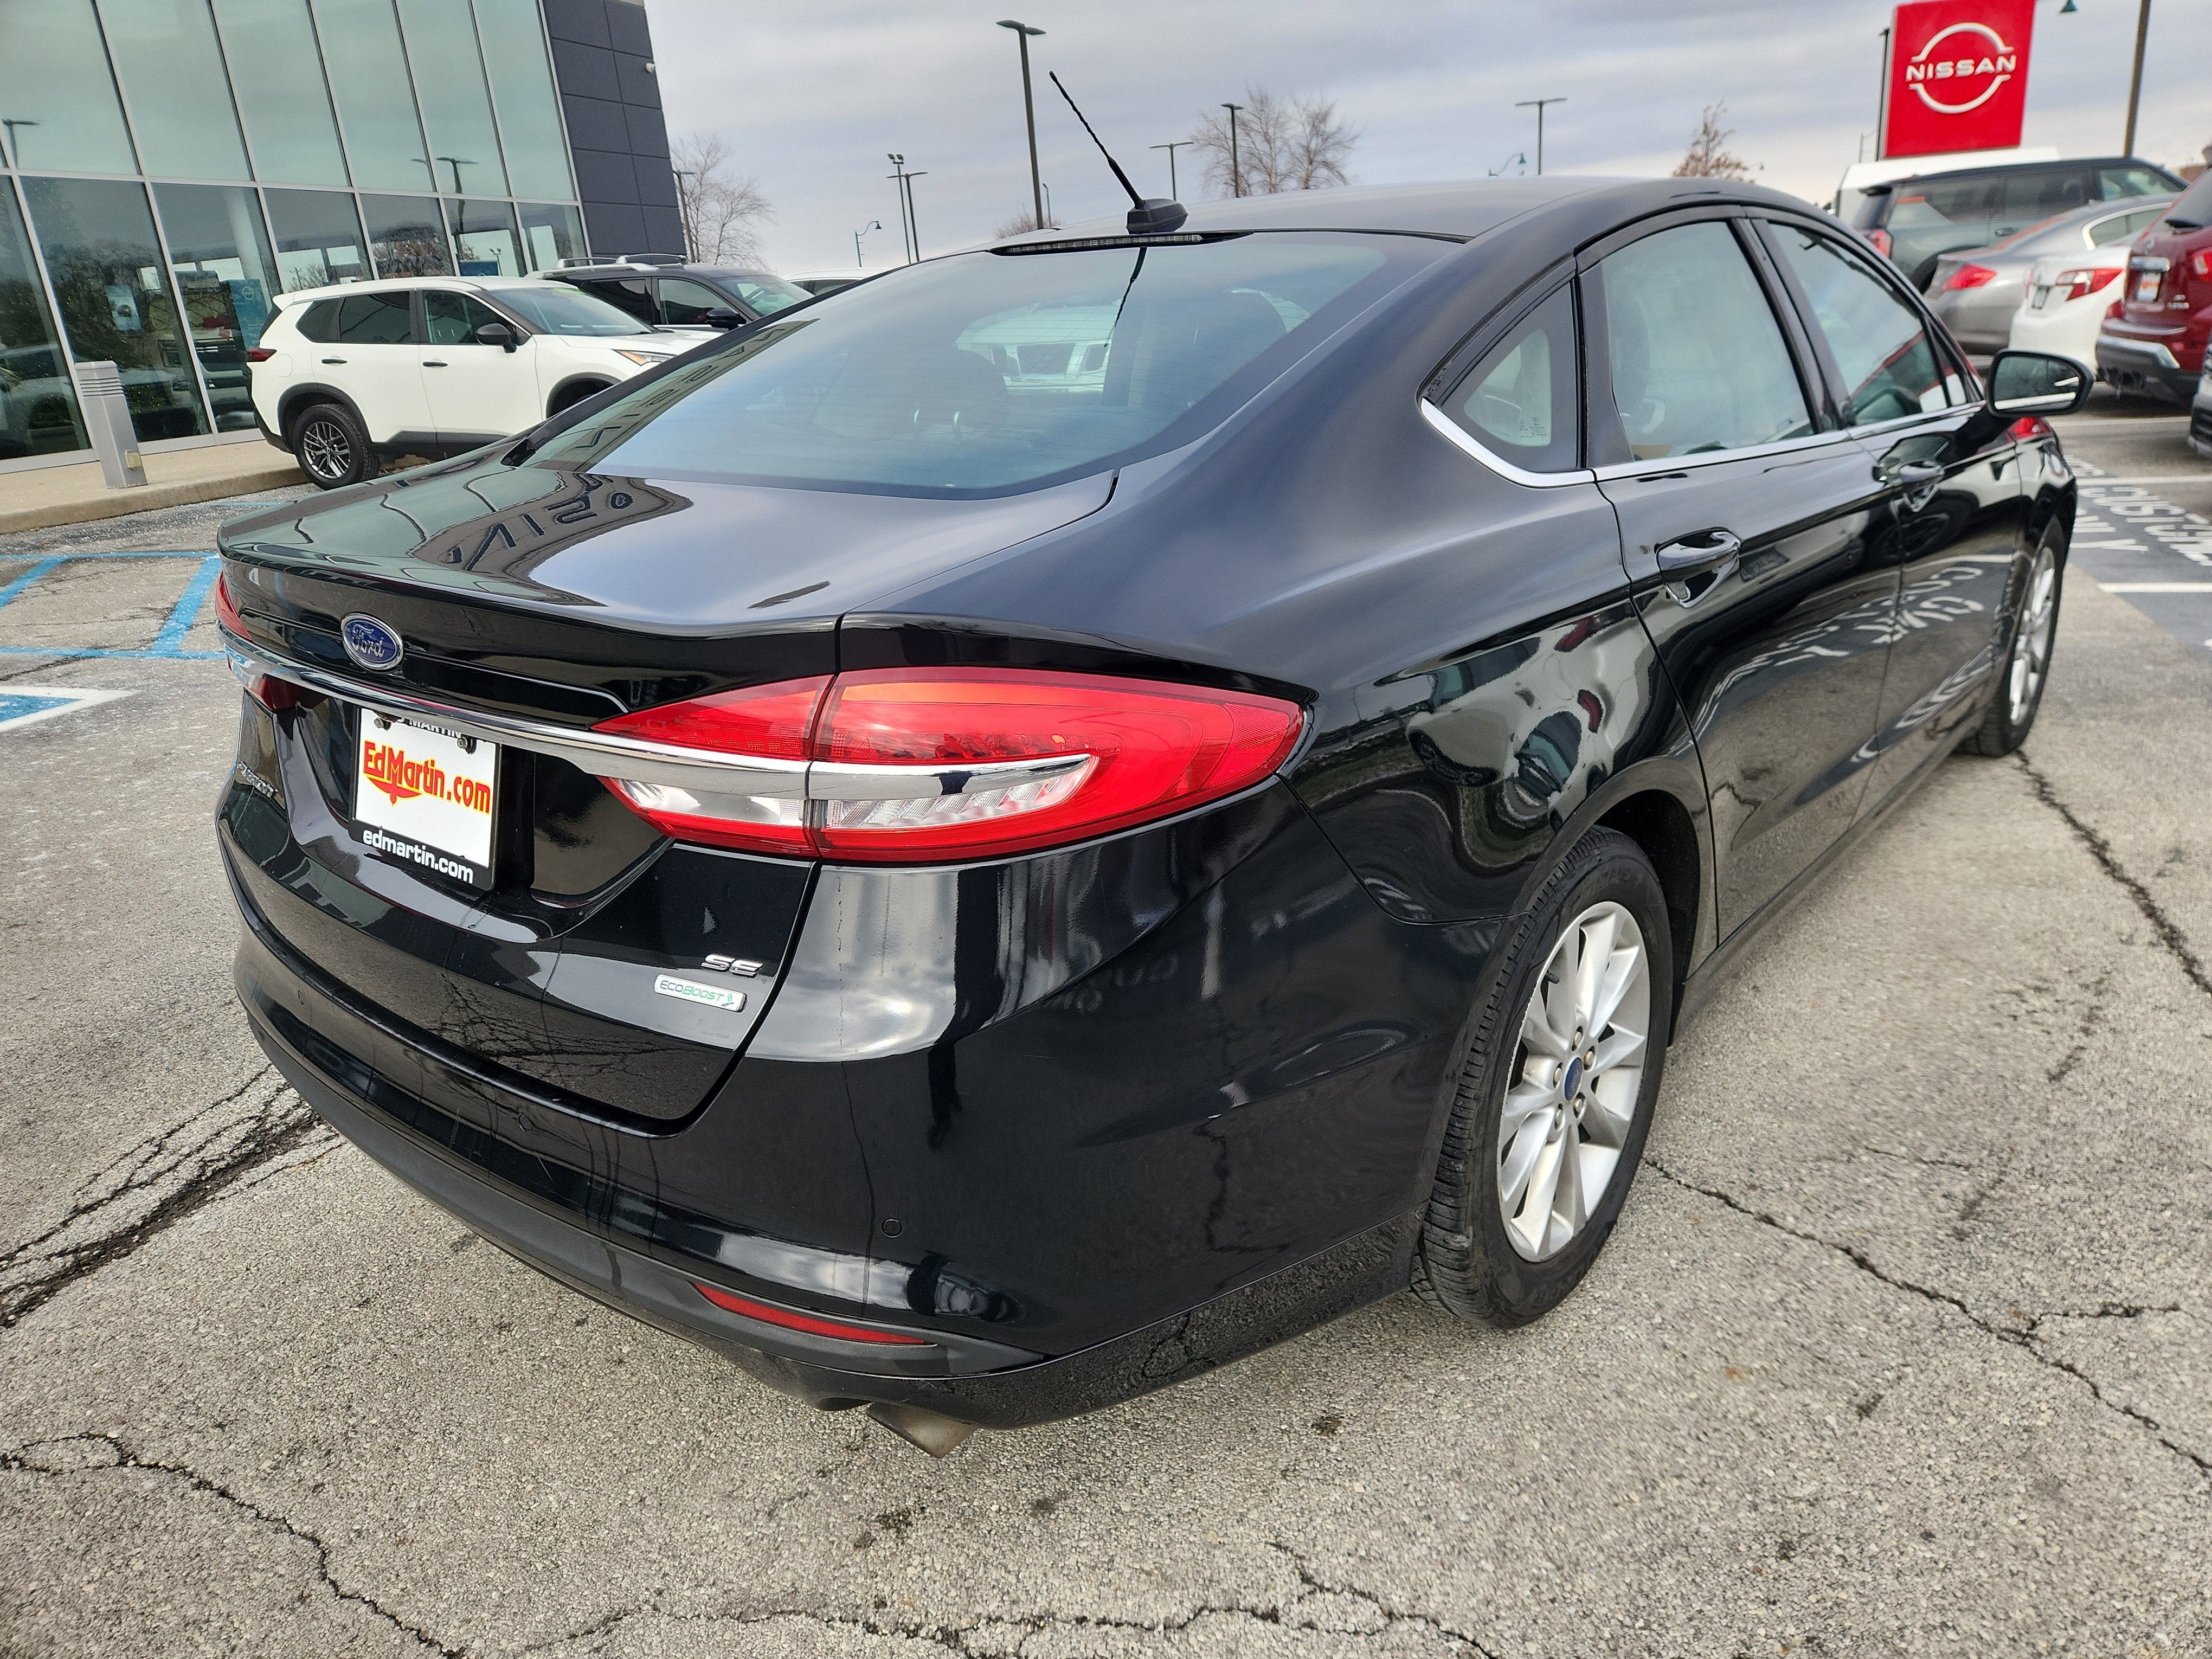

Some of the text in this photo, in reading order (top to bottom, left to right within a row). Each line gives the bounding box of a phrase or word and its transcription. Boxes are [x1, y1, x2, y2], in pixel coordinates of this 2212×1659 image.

[1906, 54, 2017, 82] NISSAN
[352, 623, 385, 658] Ford
[363, 740, 491, 814] EdMartin.com
[362, 829, 474, 884] edmartin.com
[701, 954, 764, 978] SE
[659, 979, 725, 1002] ECOBOOST
